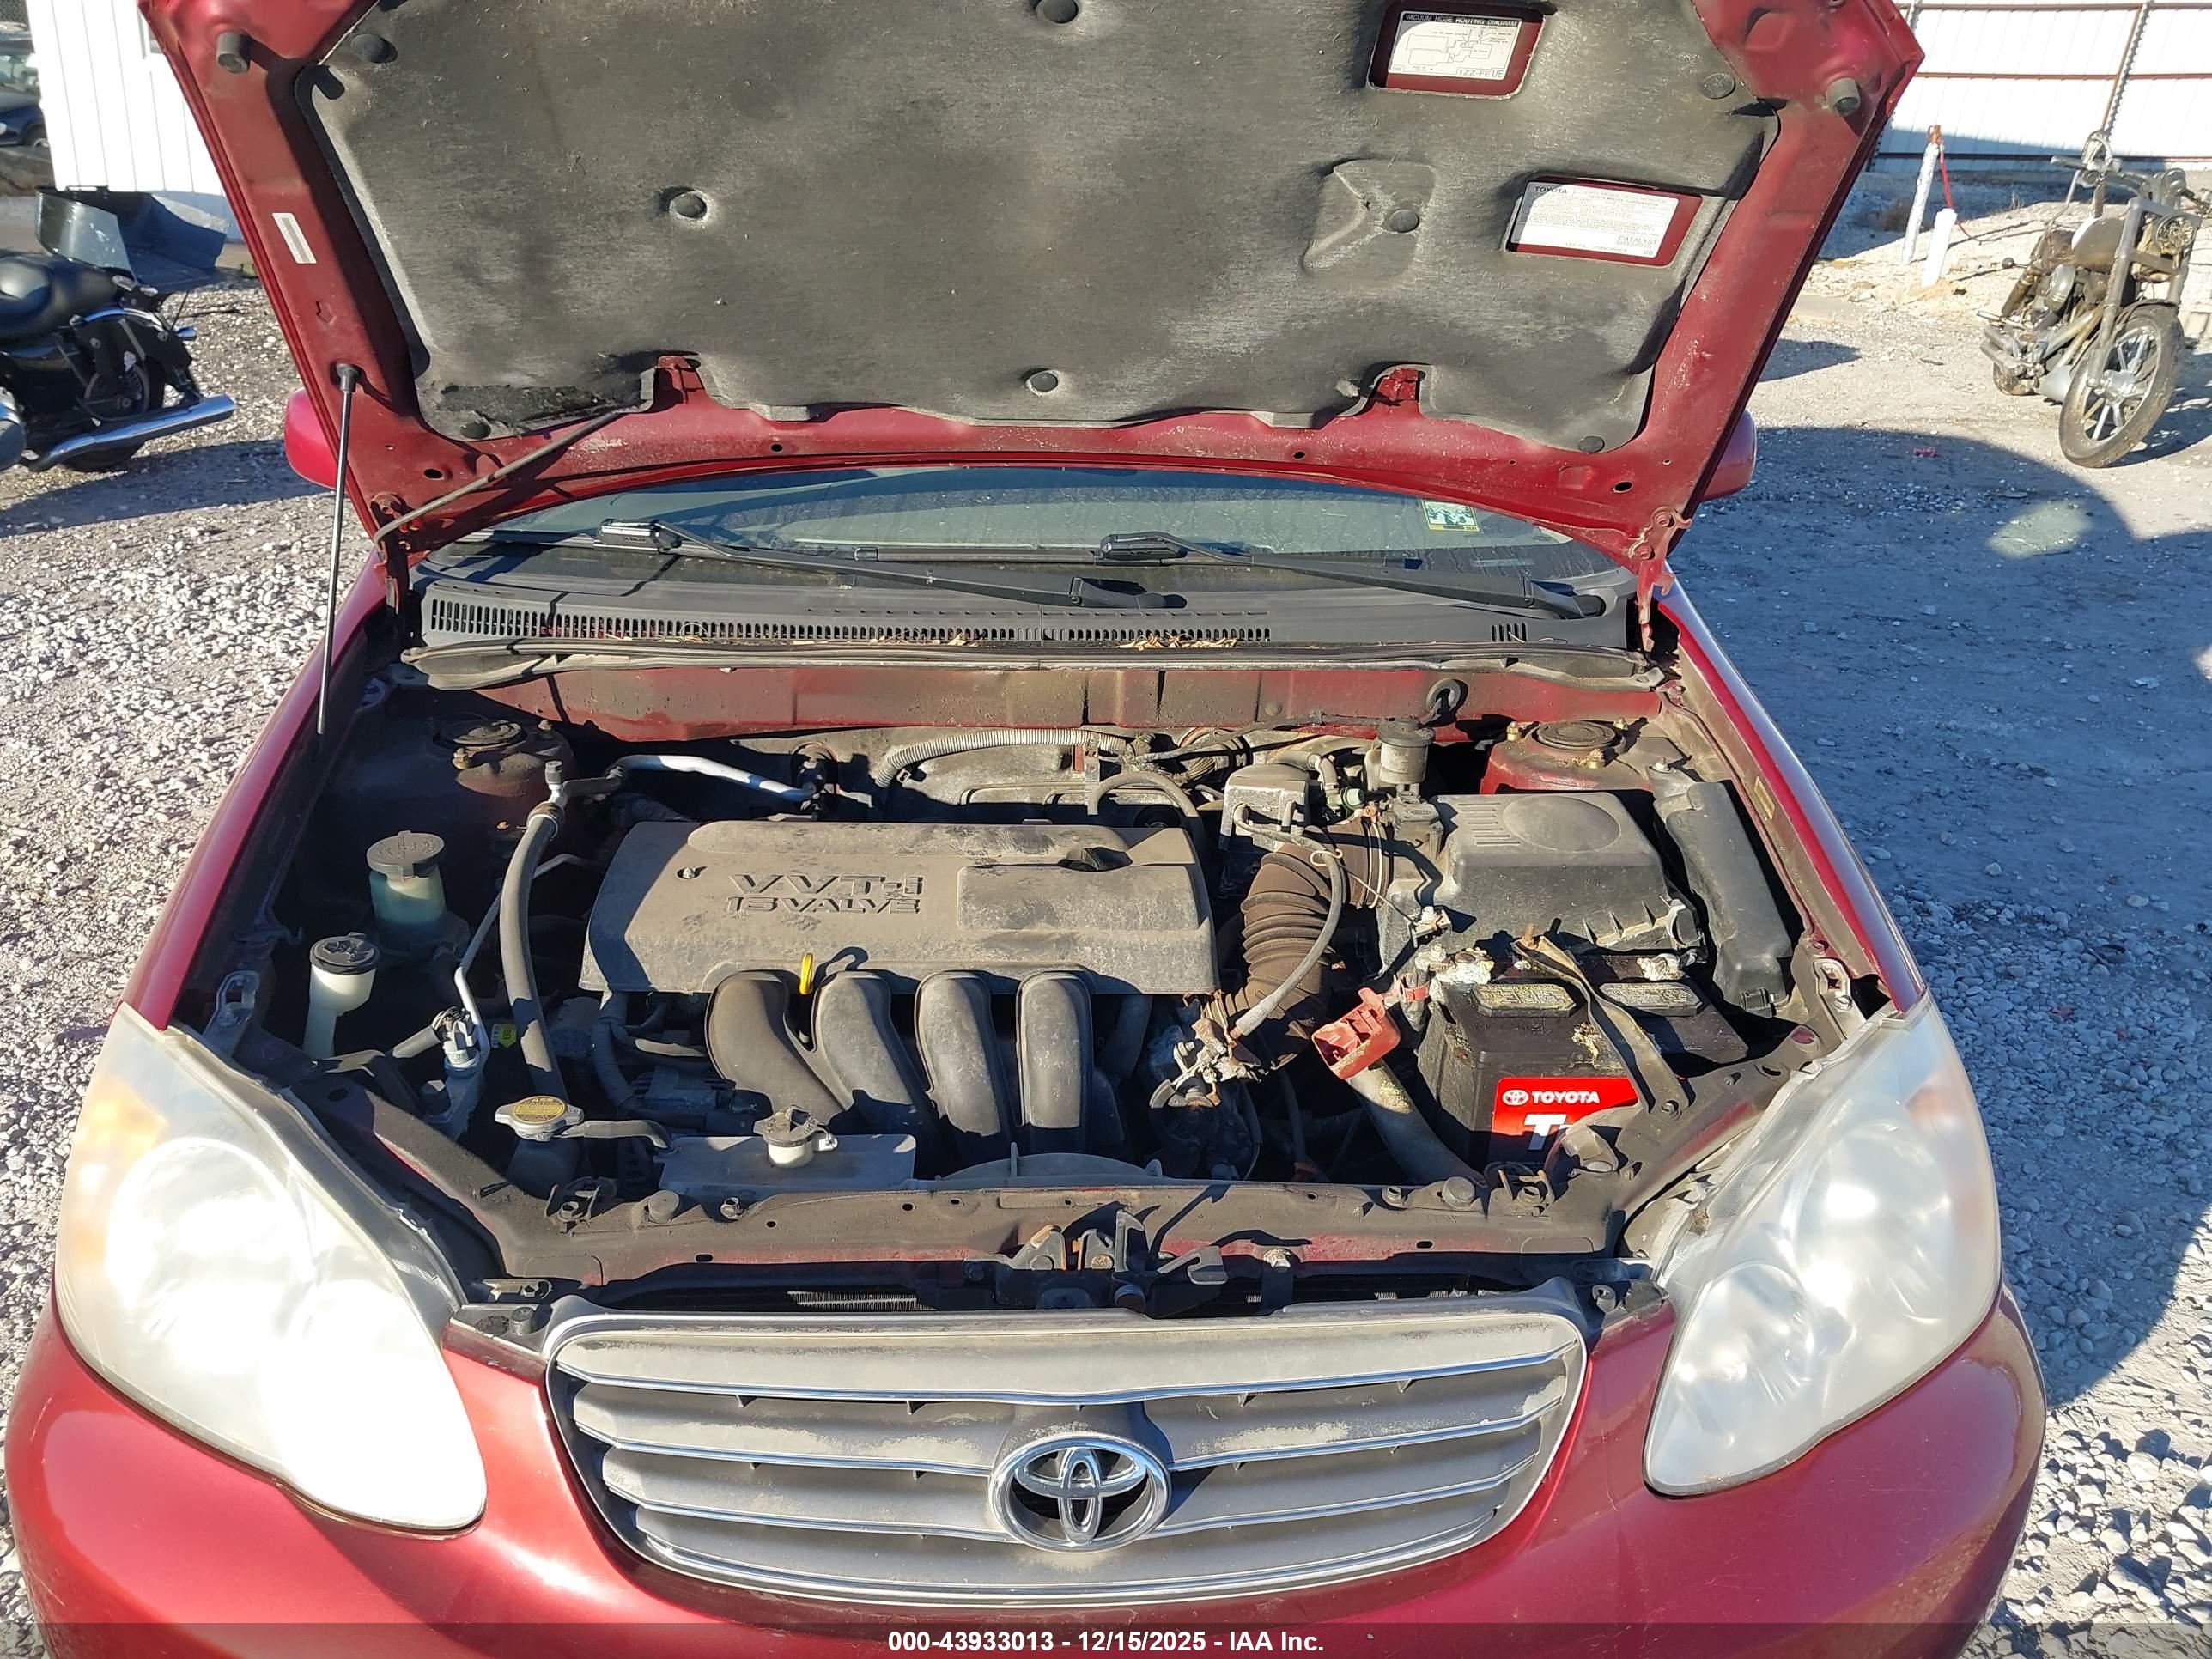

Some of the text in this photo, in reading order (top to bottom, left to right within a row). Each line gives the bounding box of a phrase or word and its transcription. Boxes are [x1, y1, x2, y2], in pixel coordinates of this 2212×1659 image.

[1534, 186, 1568, 195] TOYOTA
[1618, 235, 1658, 245] CATALYST
[1531, 1091, 1600, 1104] TOYOTA
